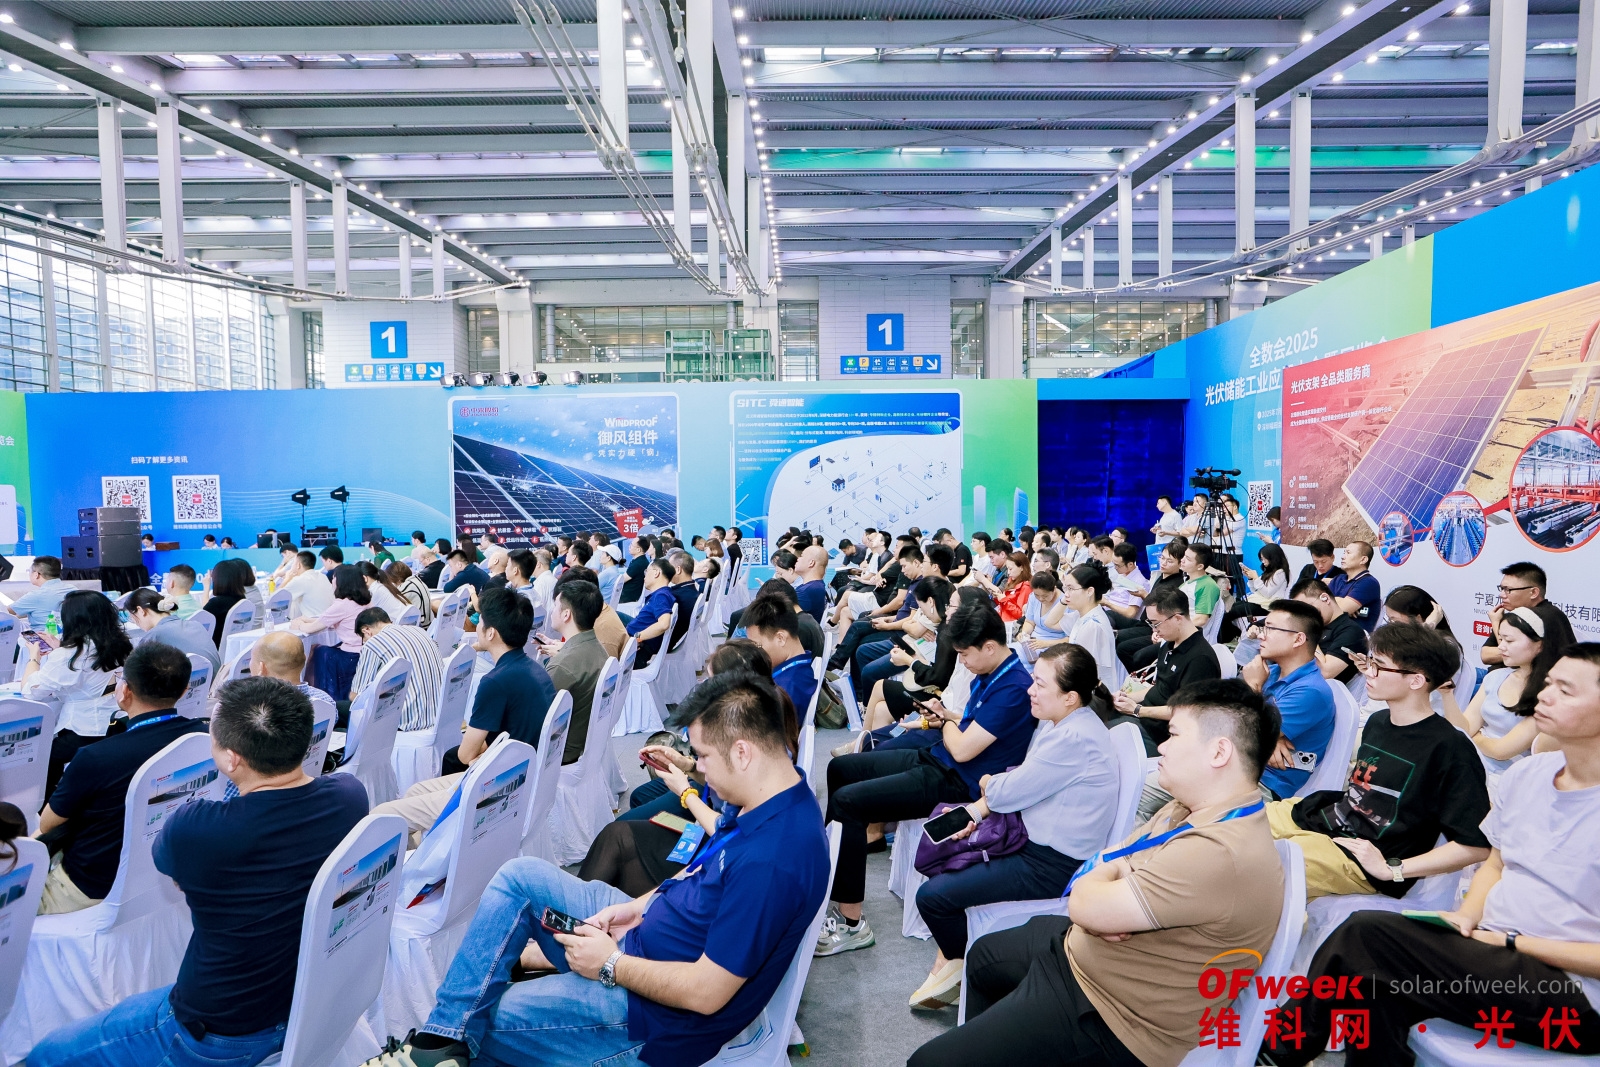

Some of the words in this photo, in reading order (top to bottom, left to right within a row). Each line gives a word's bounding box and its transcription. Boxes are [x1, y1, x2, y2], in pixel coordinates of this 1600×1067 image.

[381, 326, 396, 353] 1
[878, 319, 893, 345] 1
[1250, 327, 1319, 369] 全数会2025
[1290, 376, 1320, 394] 光伏支架
[1320, 364, 1371, 388] 全品类服务商
[737, 398, 767, 408] SITC
[604, 415, 658, 428] WINDPROOF
[597, 430, 659, 446] 御风组件
[131, 456, 189, 465] 扫码了解更多资讯
[623, 522, 639, 533] 3倍
